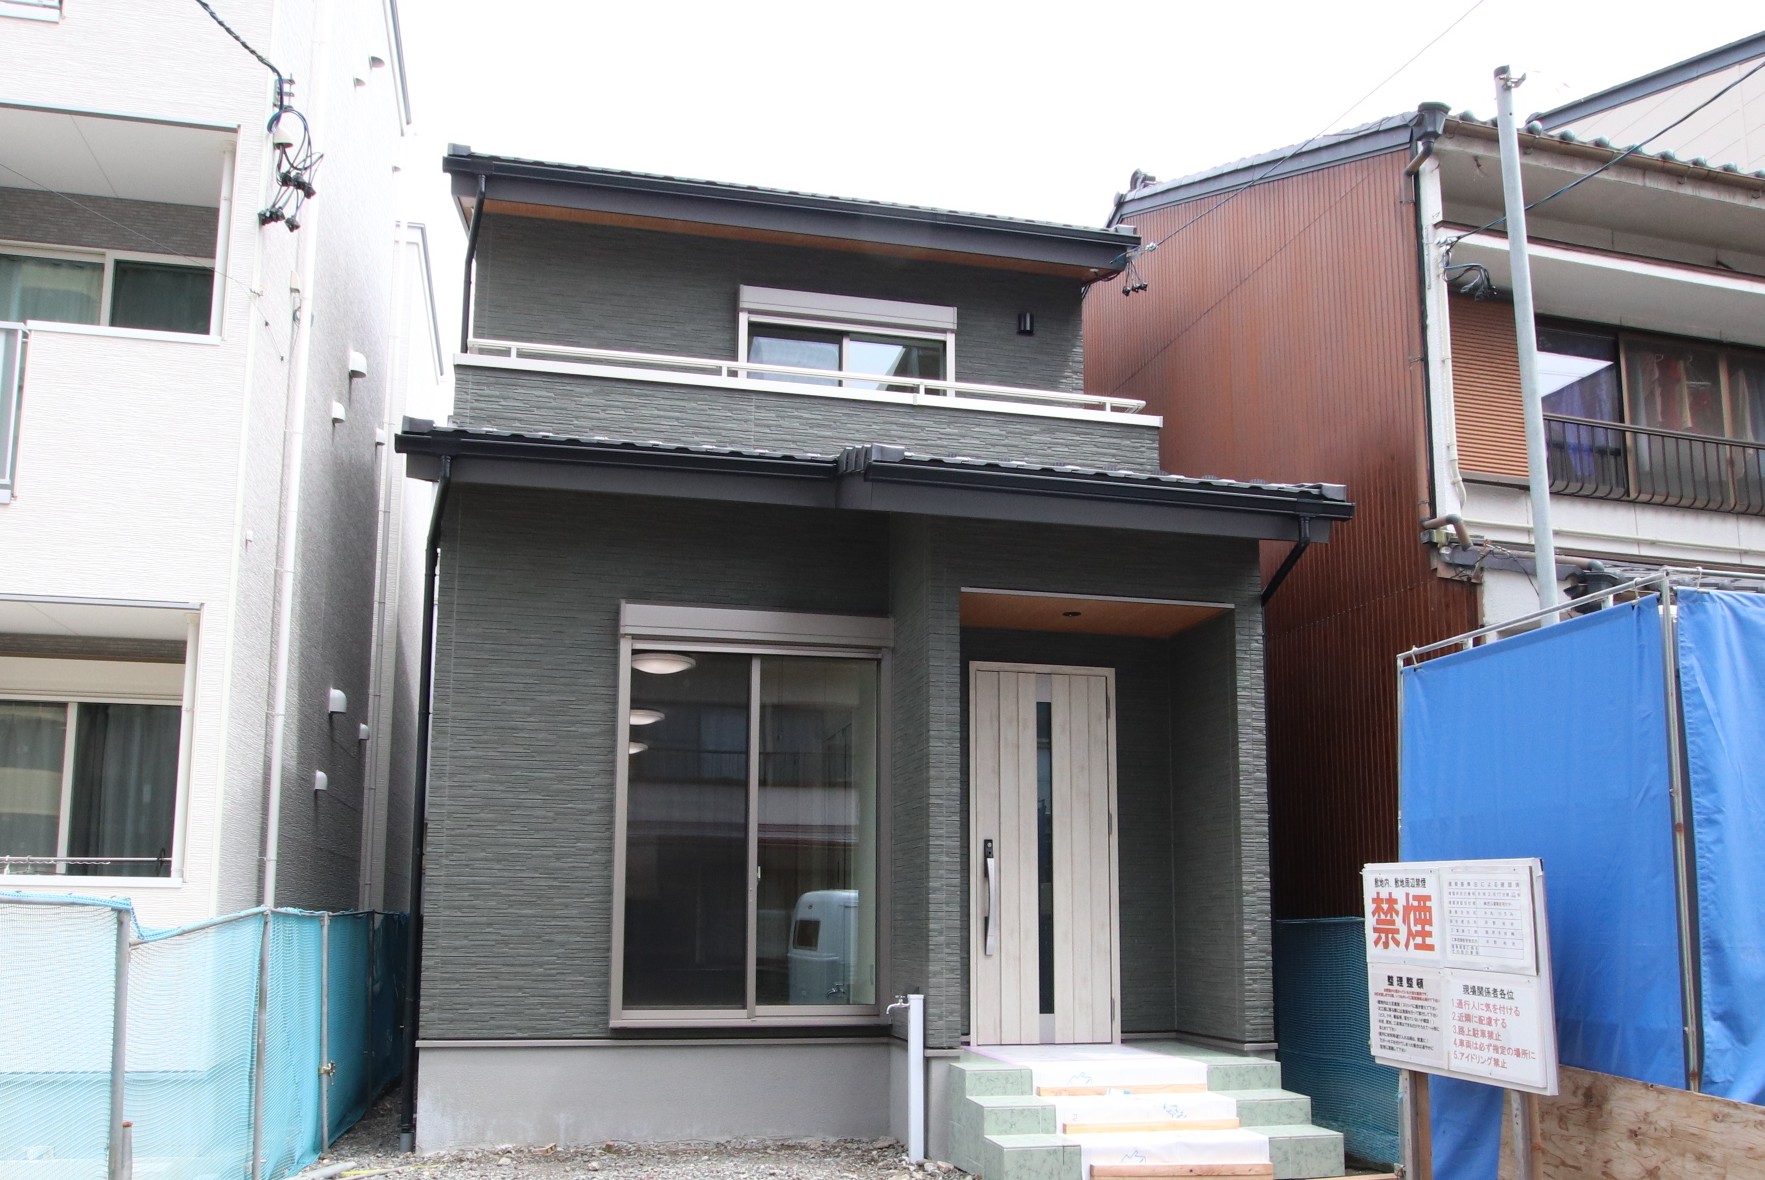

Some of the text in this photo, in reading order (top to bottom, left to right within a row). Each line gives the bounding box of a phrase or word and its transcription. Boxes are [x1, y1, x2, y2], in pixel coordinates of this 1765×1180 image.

[1371, 891, 1435, 952] 禁煙
[1387, 975, 1424, 989] 整理整頓
[1462, 984, 1514, 1000] 現場関係者各位
[1452, 998, 1520, 1017] 1.通行人に気を付ける
[1452, 1012, 1507, 1029] 2.近隣に配慮する
[1452, 1025, 1503, 1042] 3.路上駐車禁止
[1453, 1038, 1536, 1059] 4.車両は必ず指定の場所に
[1453, 1050, 1508, 1069] 5.アイドリング禁止
